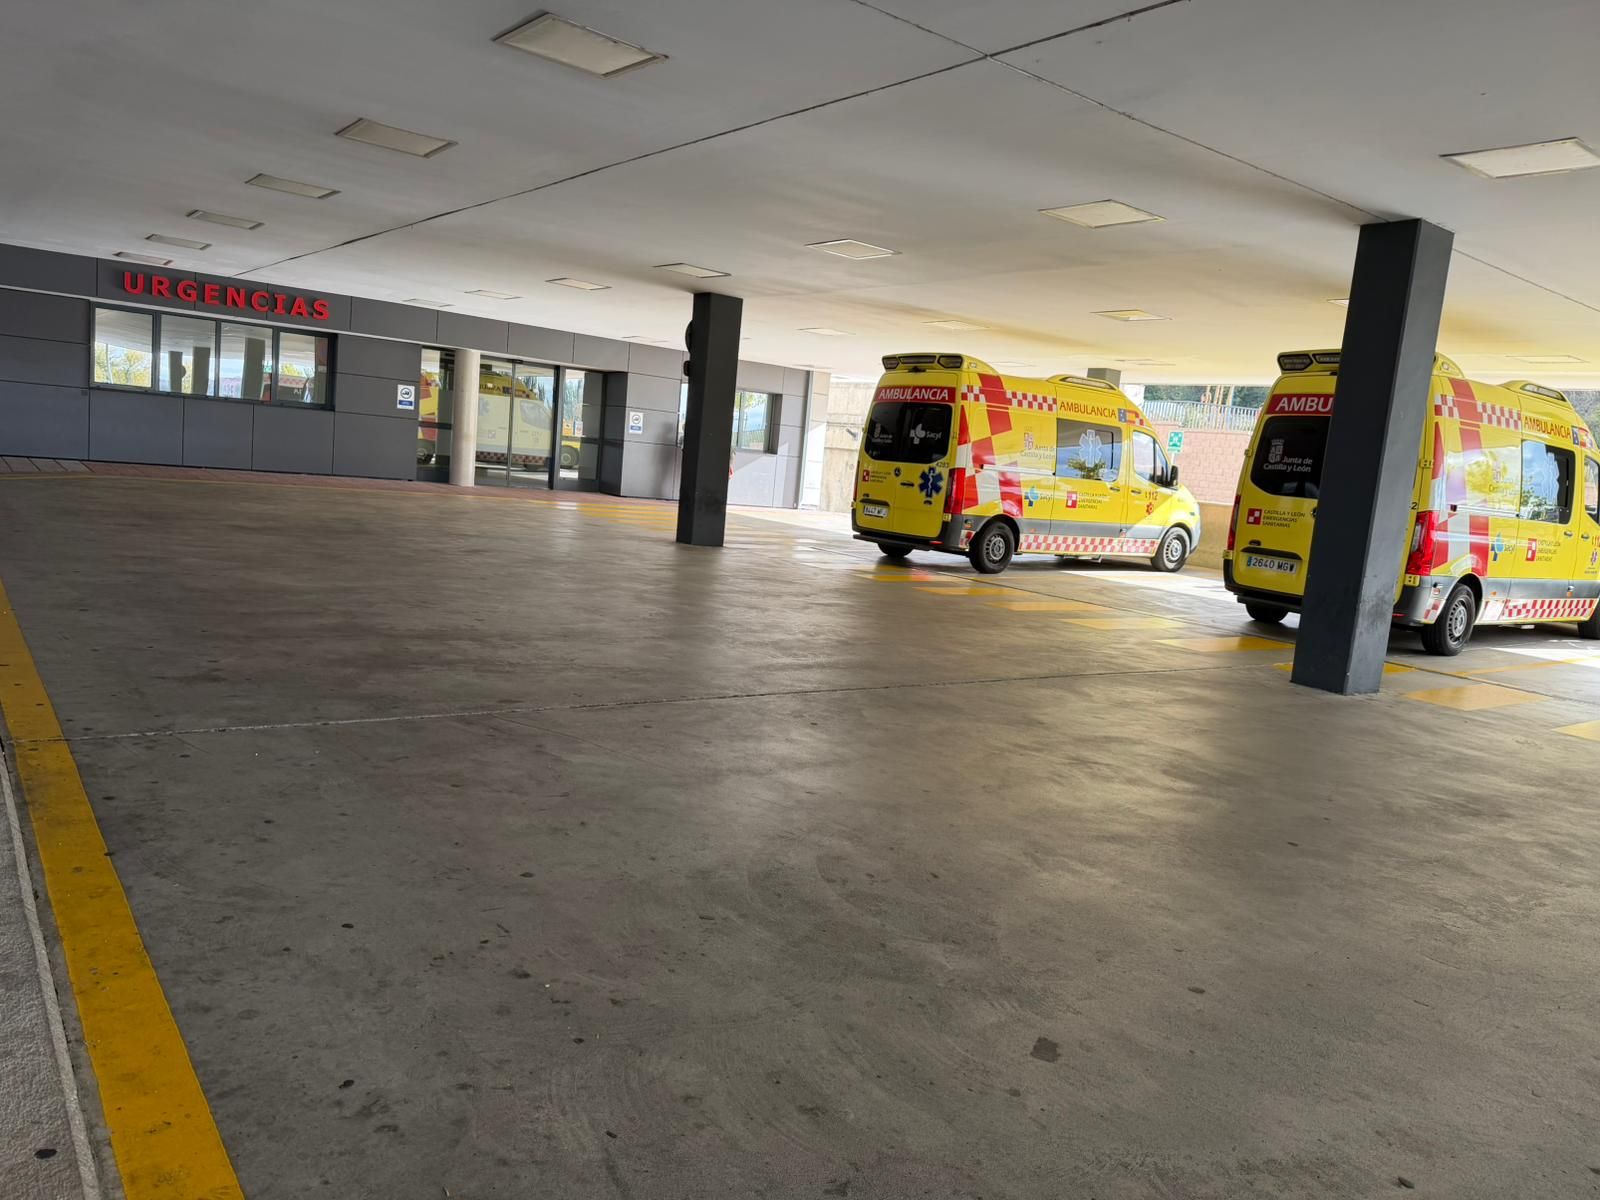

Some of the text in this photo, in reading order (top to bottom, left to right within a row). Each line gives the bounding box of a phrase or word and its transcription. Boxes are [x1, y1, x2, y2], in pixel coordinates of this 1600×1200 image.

[123, 271, 329, 320] URGENCIAS
[878, 387, 948, 400] AMBULANCIA
[1060, 401, 1117, 418] AMBULANCIA
[1524, 416, 1571, 439] AMBULANCIA
[1282, 456, 1312, 465] Junta de
[1293, 464, 1311, 472] León
[1252, 557, 1275, 569] 2640
